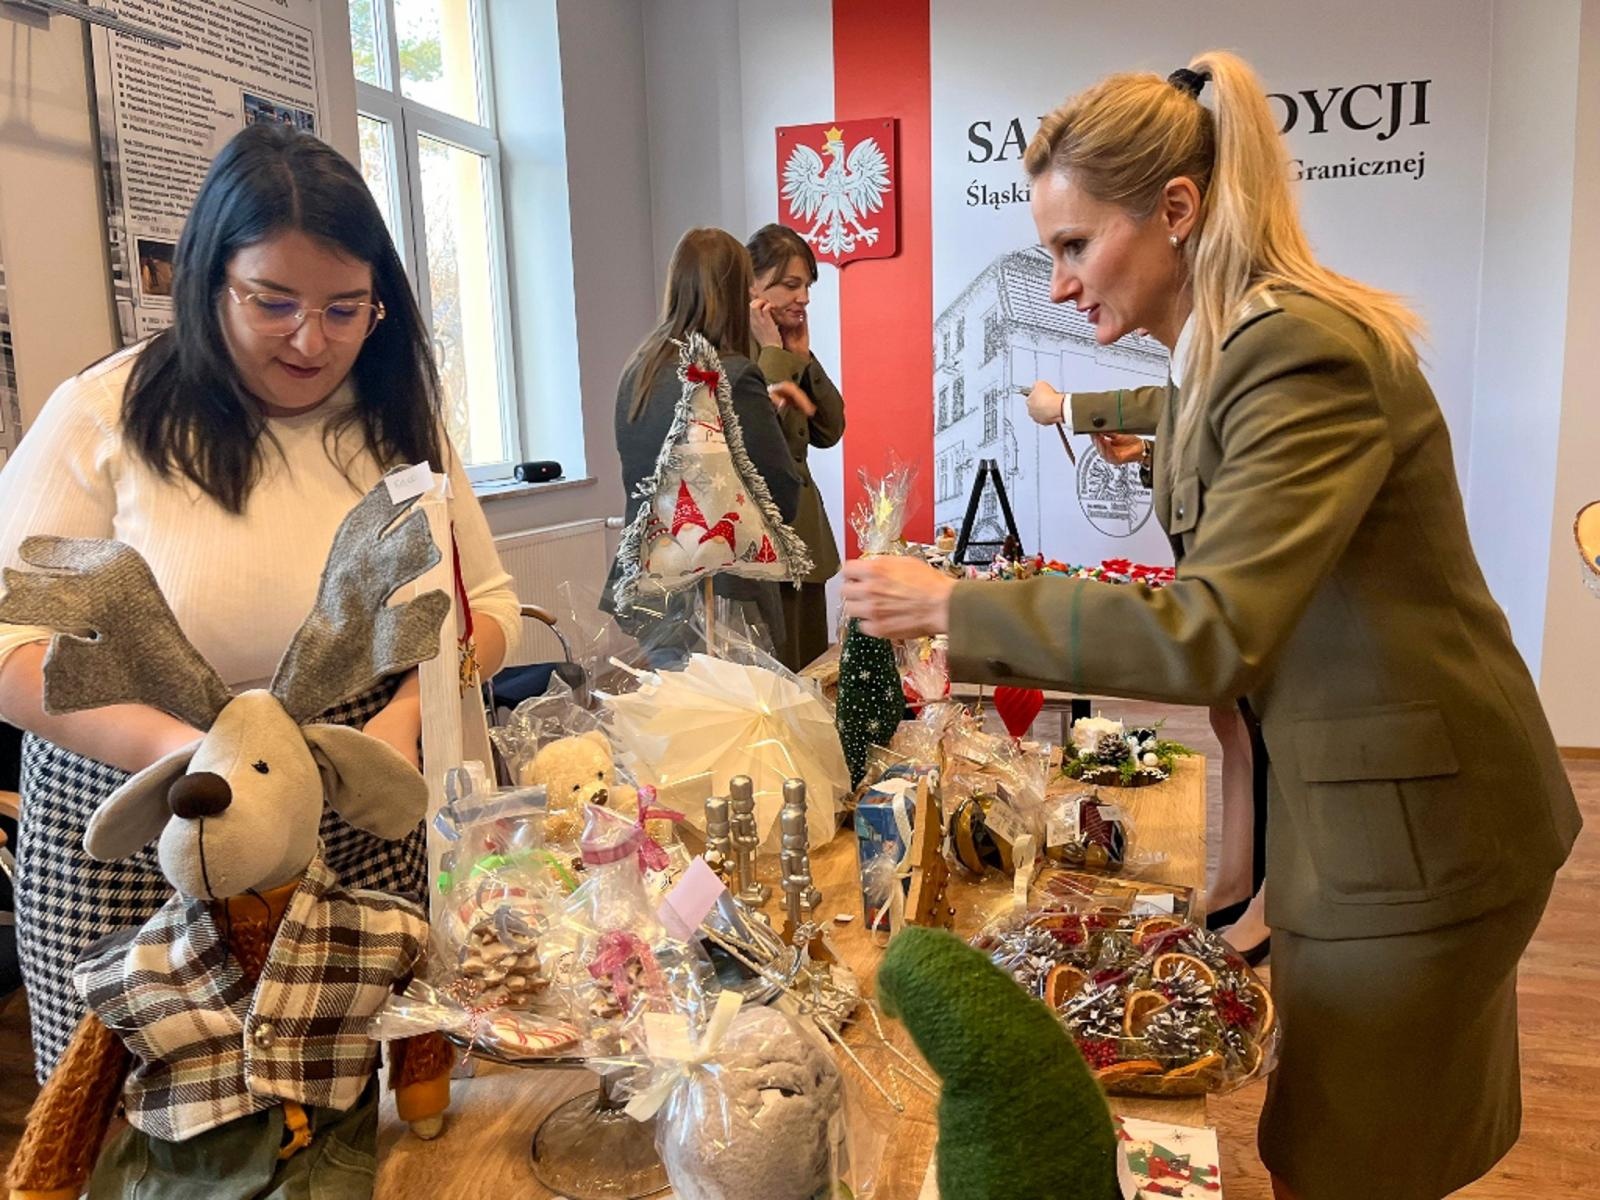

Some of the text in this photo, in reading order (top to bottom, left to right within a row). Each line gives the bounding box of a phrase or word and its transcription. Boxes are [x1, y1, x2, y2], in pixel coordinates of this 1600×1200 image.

[967, 79, 1432, 164] SA DYCJI
[966, 179, 1031, 210] Śląski
